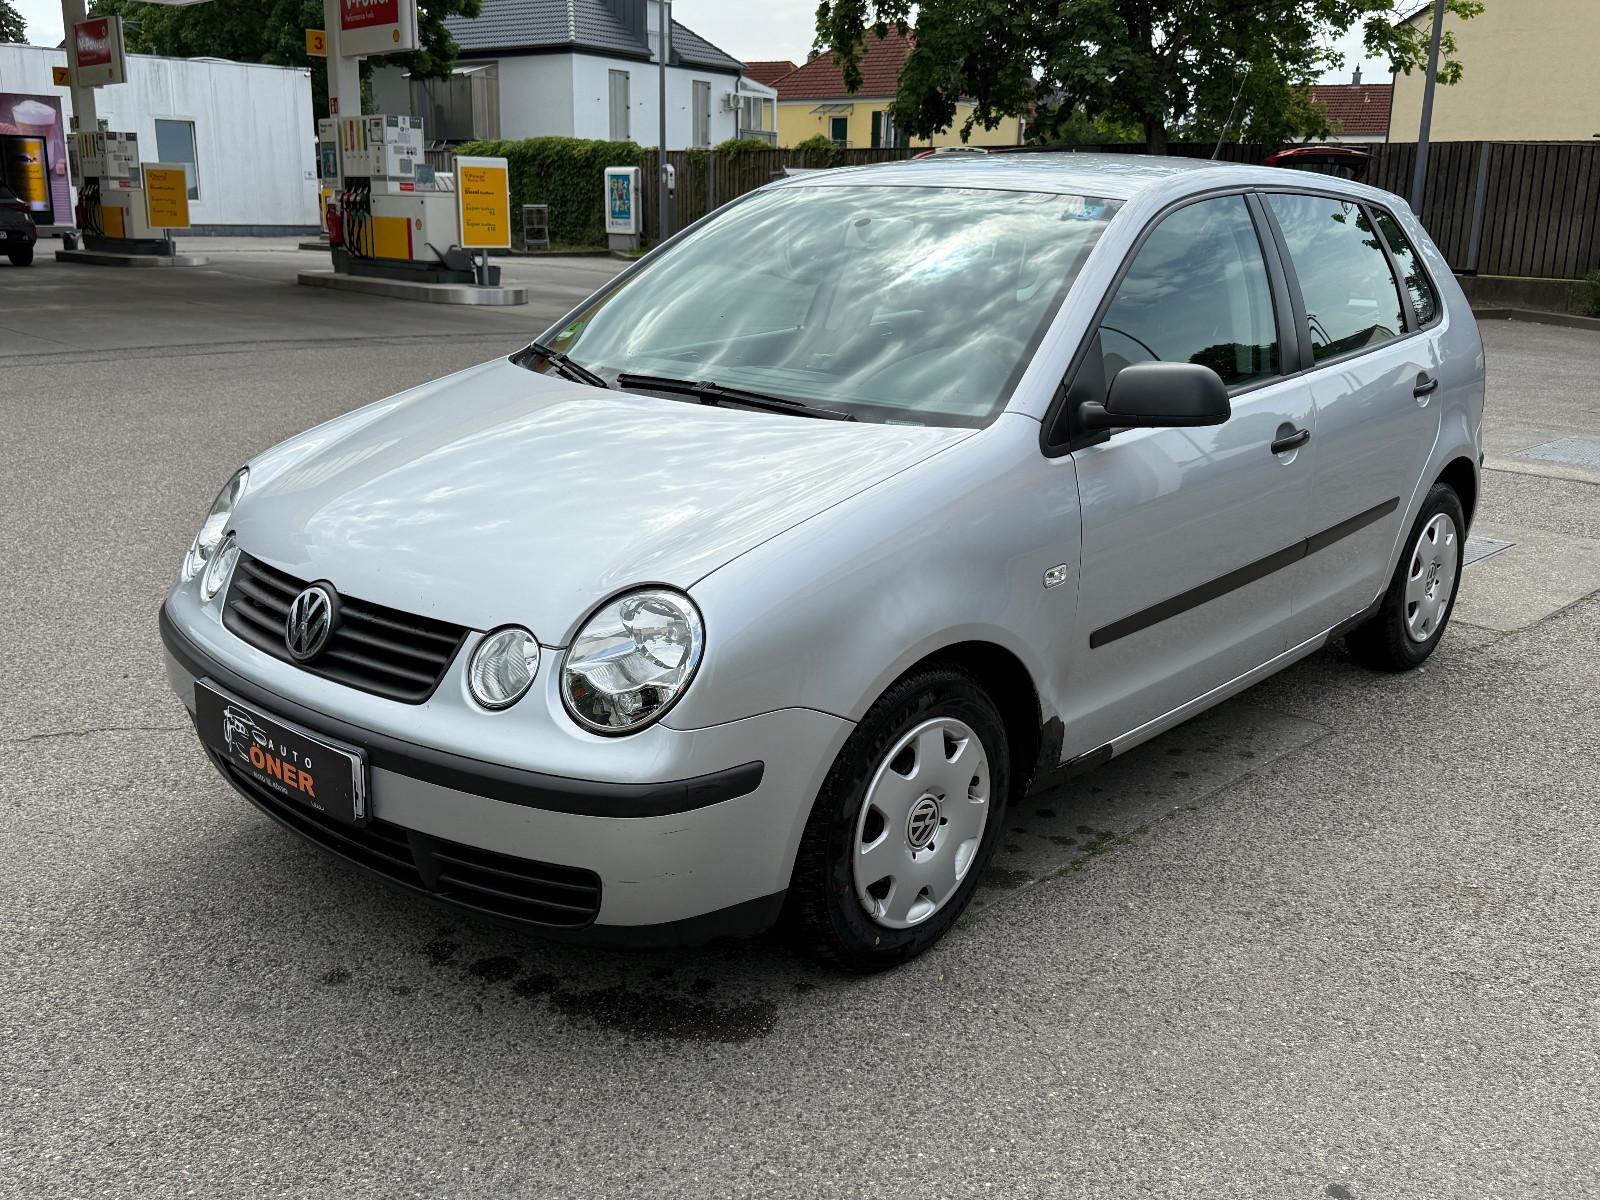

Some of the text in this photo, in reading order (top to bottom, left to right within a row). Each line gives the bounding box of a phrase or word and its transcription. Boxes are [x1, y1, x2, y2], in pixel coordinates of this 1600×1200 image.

[345, 0, 388, 10] V-Pow
[78, 38, 105, 51] V-Power
[314, 36, 323, 49] 3
[58, 72, 66, 82] 7
[268, 739, 312, 769] AUTO
[249, 741, 316, 799] ÖNER
